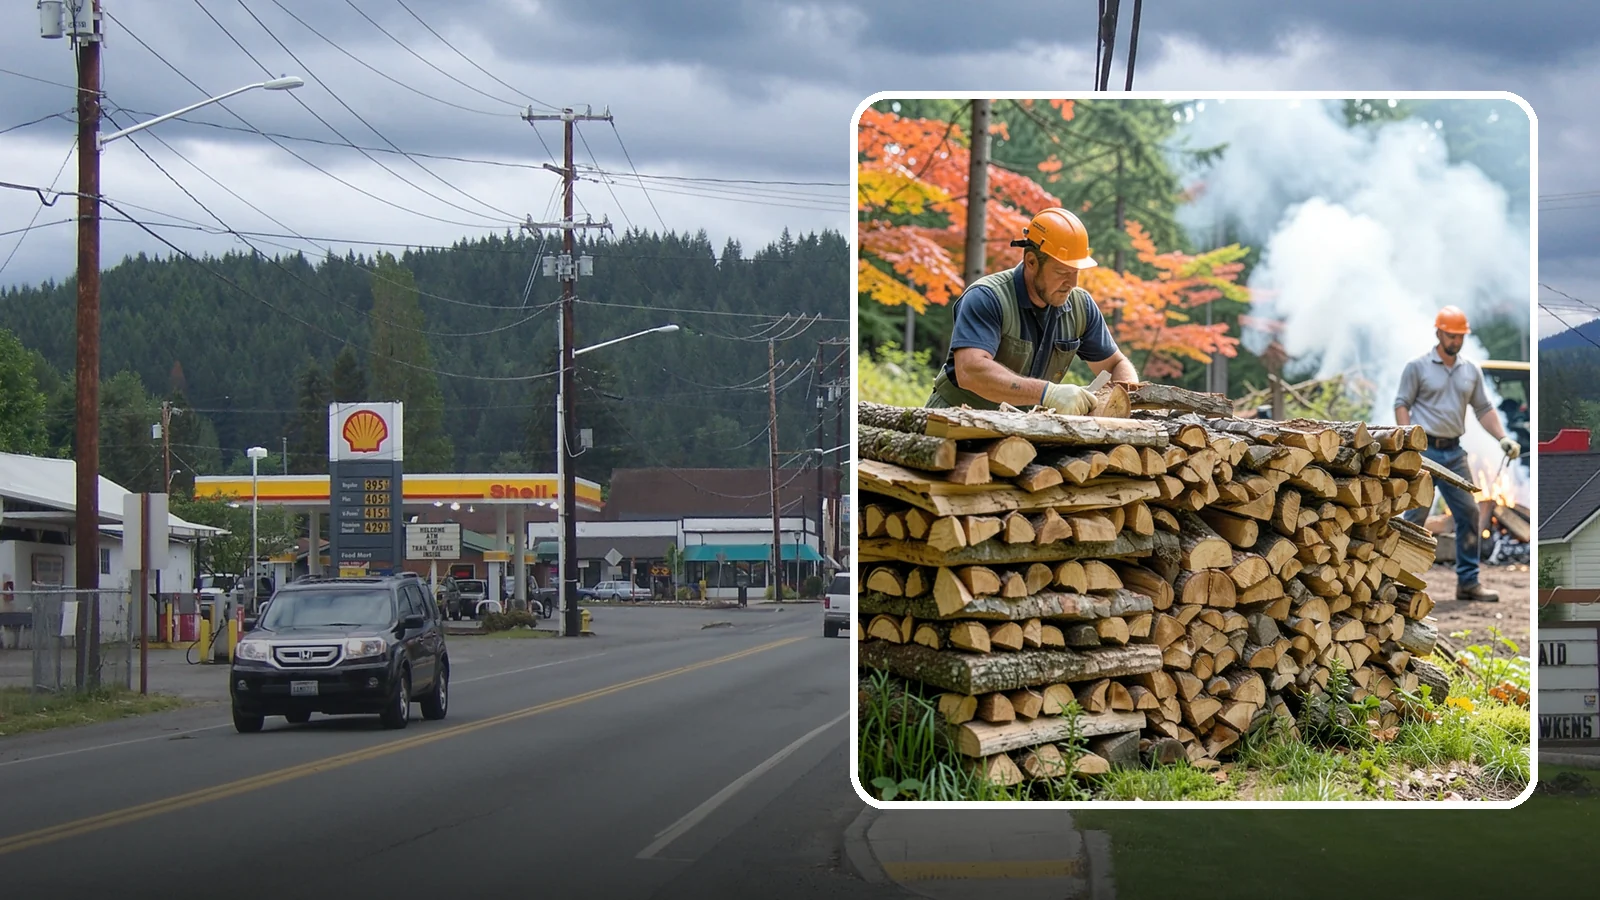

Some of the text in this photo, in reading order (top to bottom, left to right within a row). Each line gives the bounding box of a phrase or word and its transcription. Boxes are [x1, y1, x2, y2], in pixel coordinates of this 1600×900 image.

[366, 480, 384, 490] 395
[490, 484, 547, 499] Shell
[365, 494, 384, 504] 405
[365, 508, 384, 518] 415
[366, 522, 384, 533] 429
